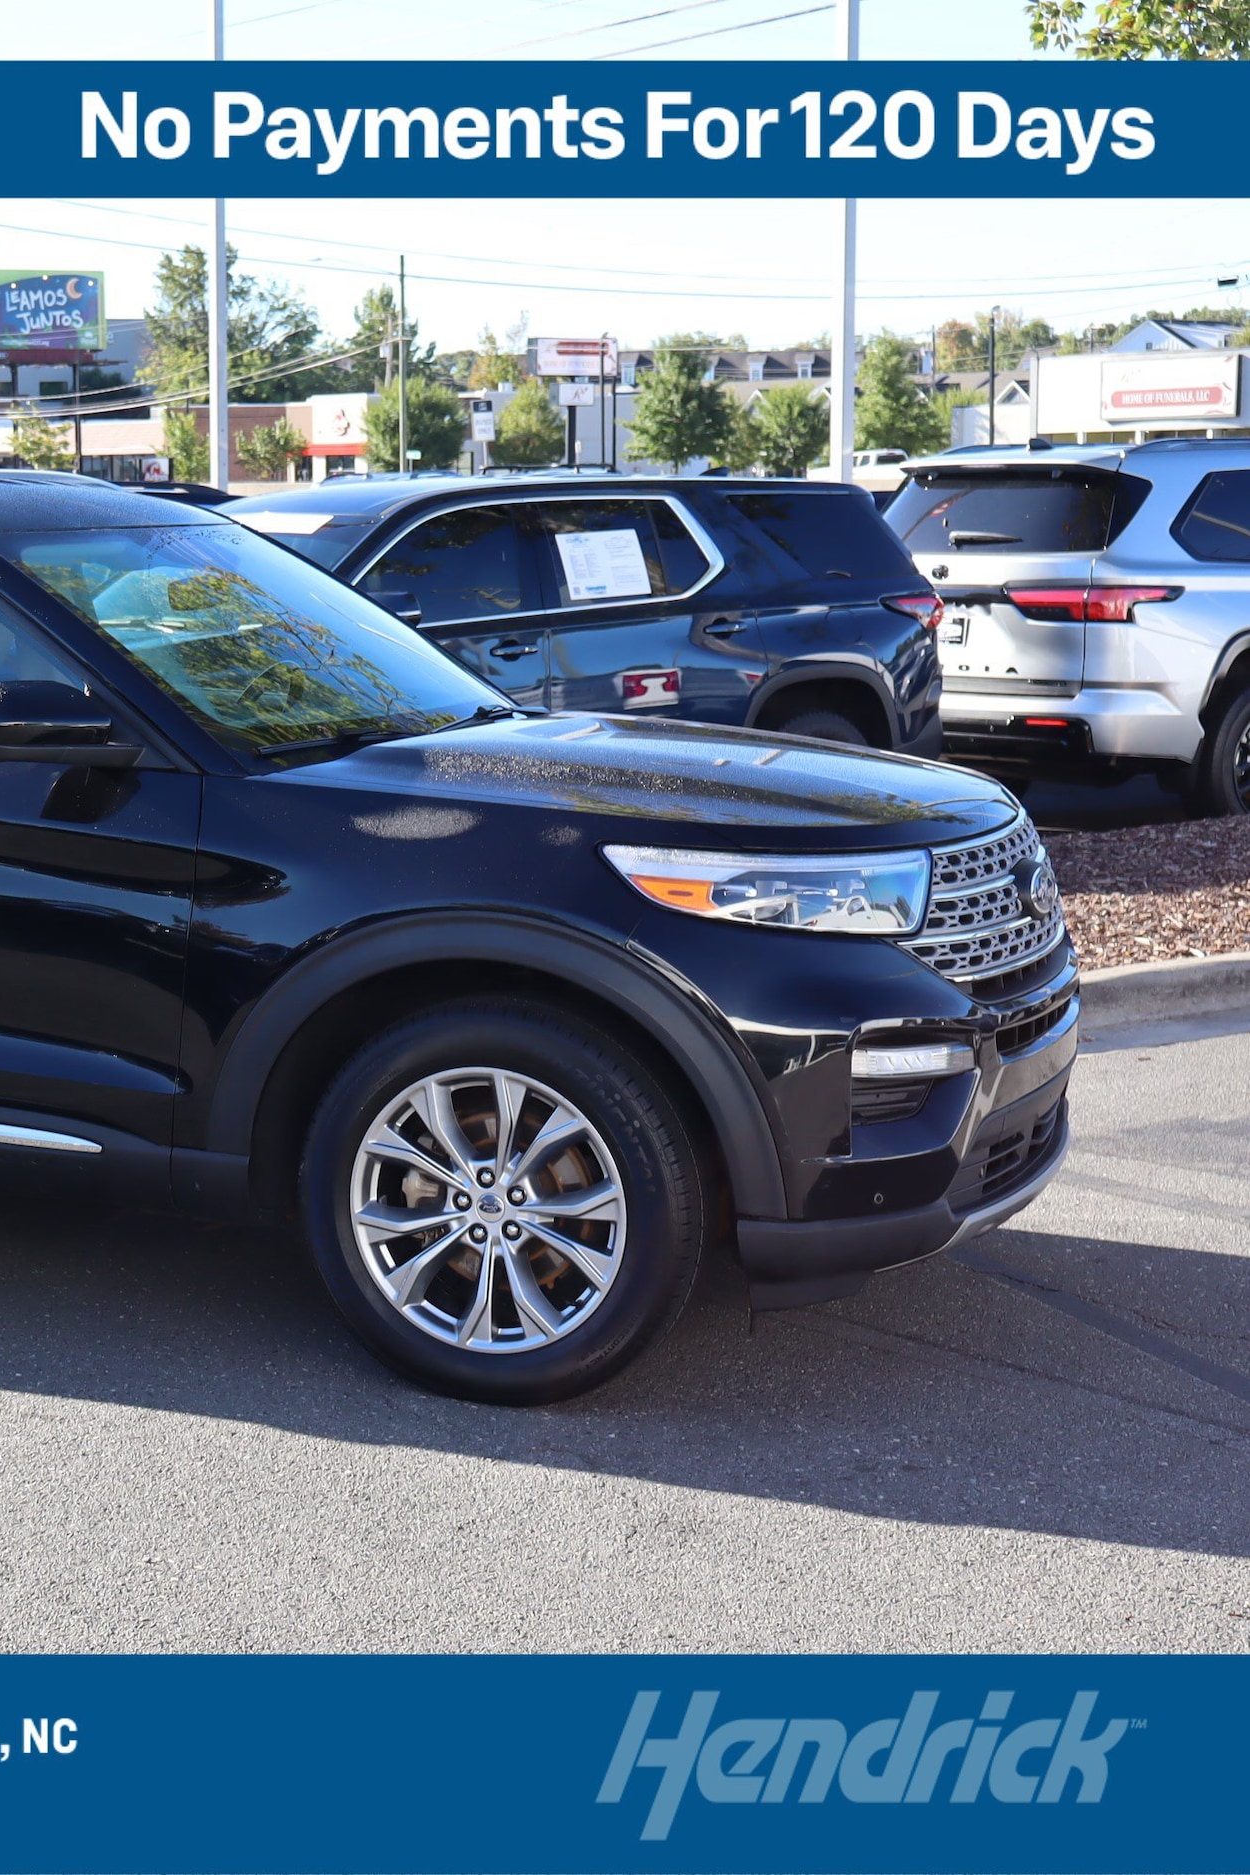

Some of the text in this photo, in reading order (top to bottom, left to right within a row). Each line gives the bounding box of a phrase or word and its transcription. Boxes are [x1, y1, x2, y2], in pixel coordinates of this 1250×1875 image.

[5, 288, 67, 312] LEAMOS
[16, 309, 84, 335] JUNTOS
[1121, 393, 1141, 404] HOME
[1144, 392, 1155, 403] OF
[1196, 390, 1210, 401] LLC
